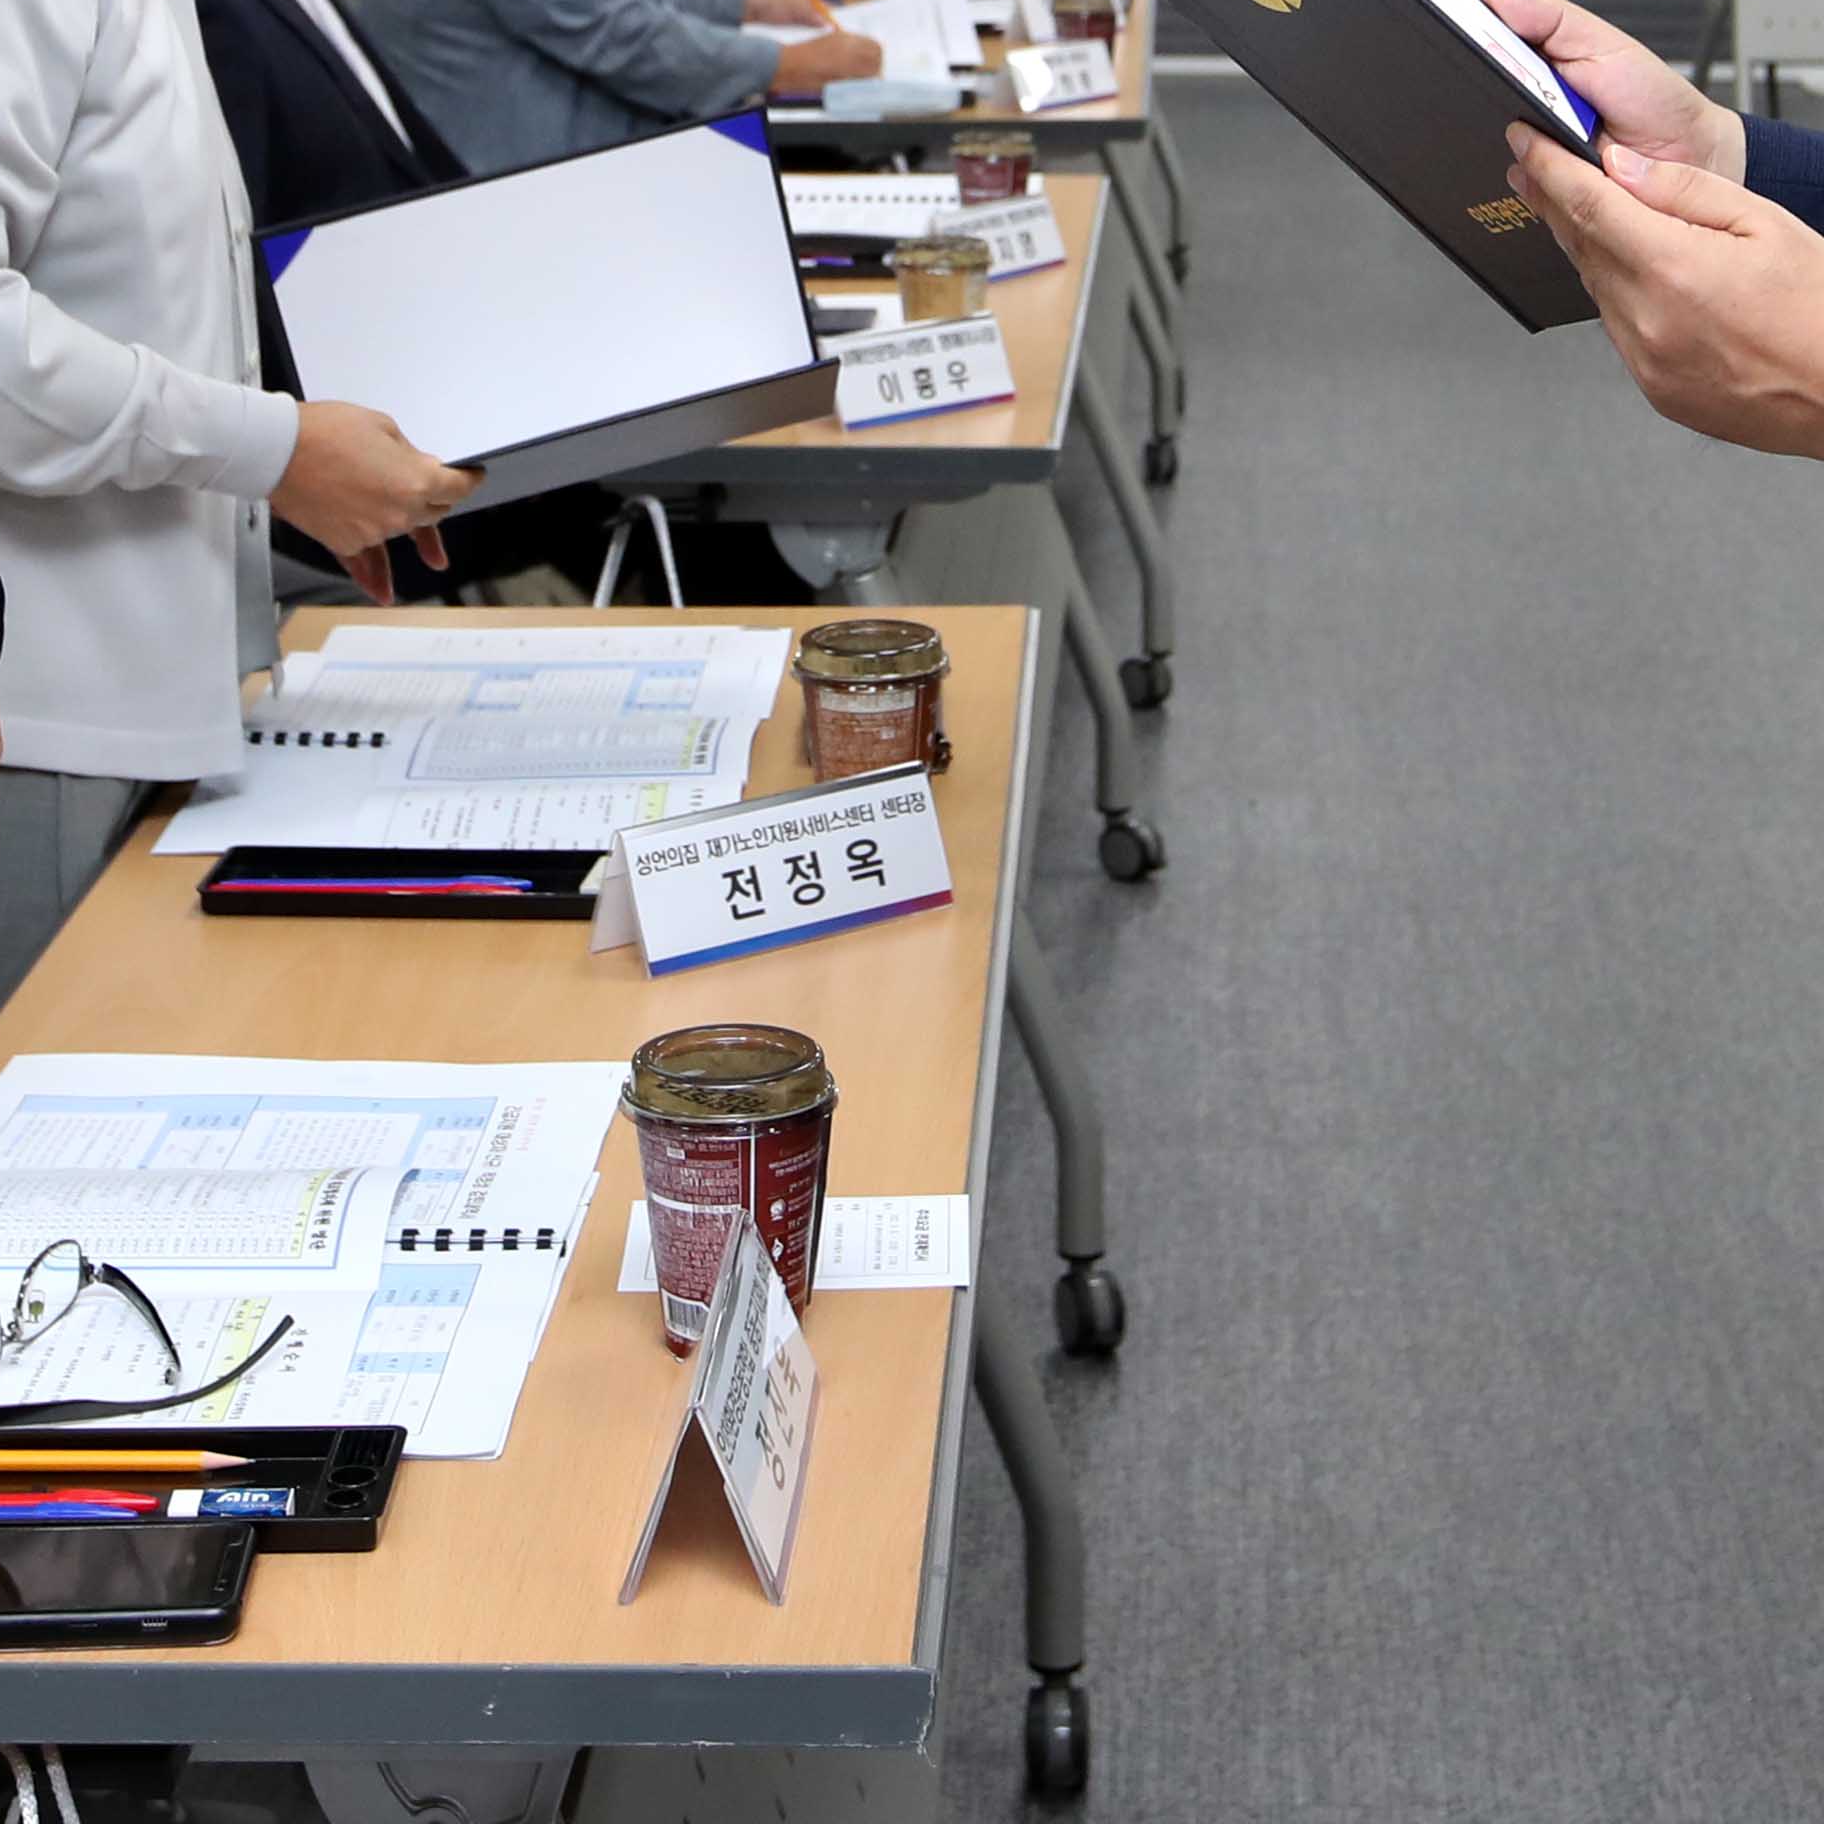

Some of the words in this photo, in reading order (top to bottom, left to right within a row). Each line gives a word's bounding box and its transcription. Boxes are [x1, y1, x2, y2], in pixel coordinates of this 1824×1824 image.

[635, 841, 701, 877] 성언의집
[705, 802, 875, 859] 재가노인지원서비스센터
[880, 791, 927, 821] 센터장
[216, 1491, 271, 1504] Ain
